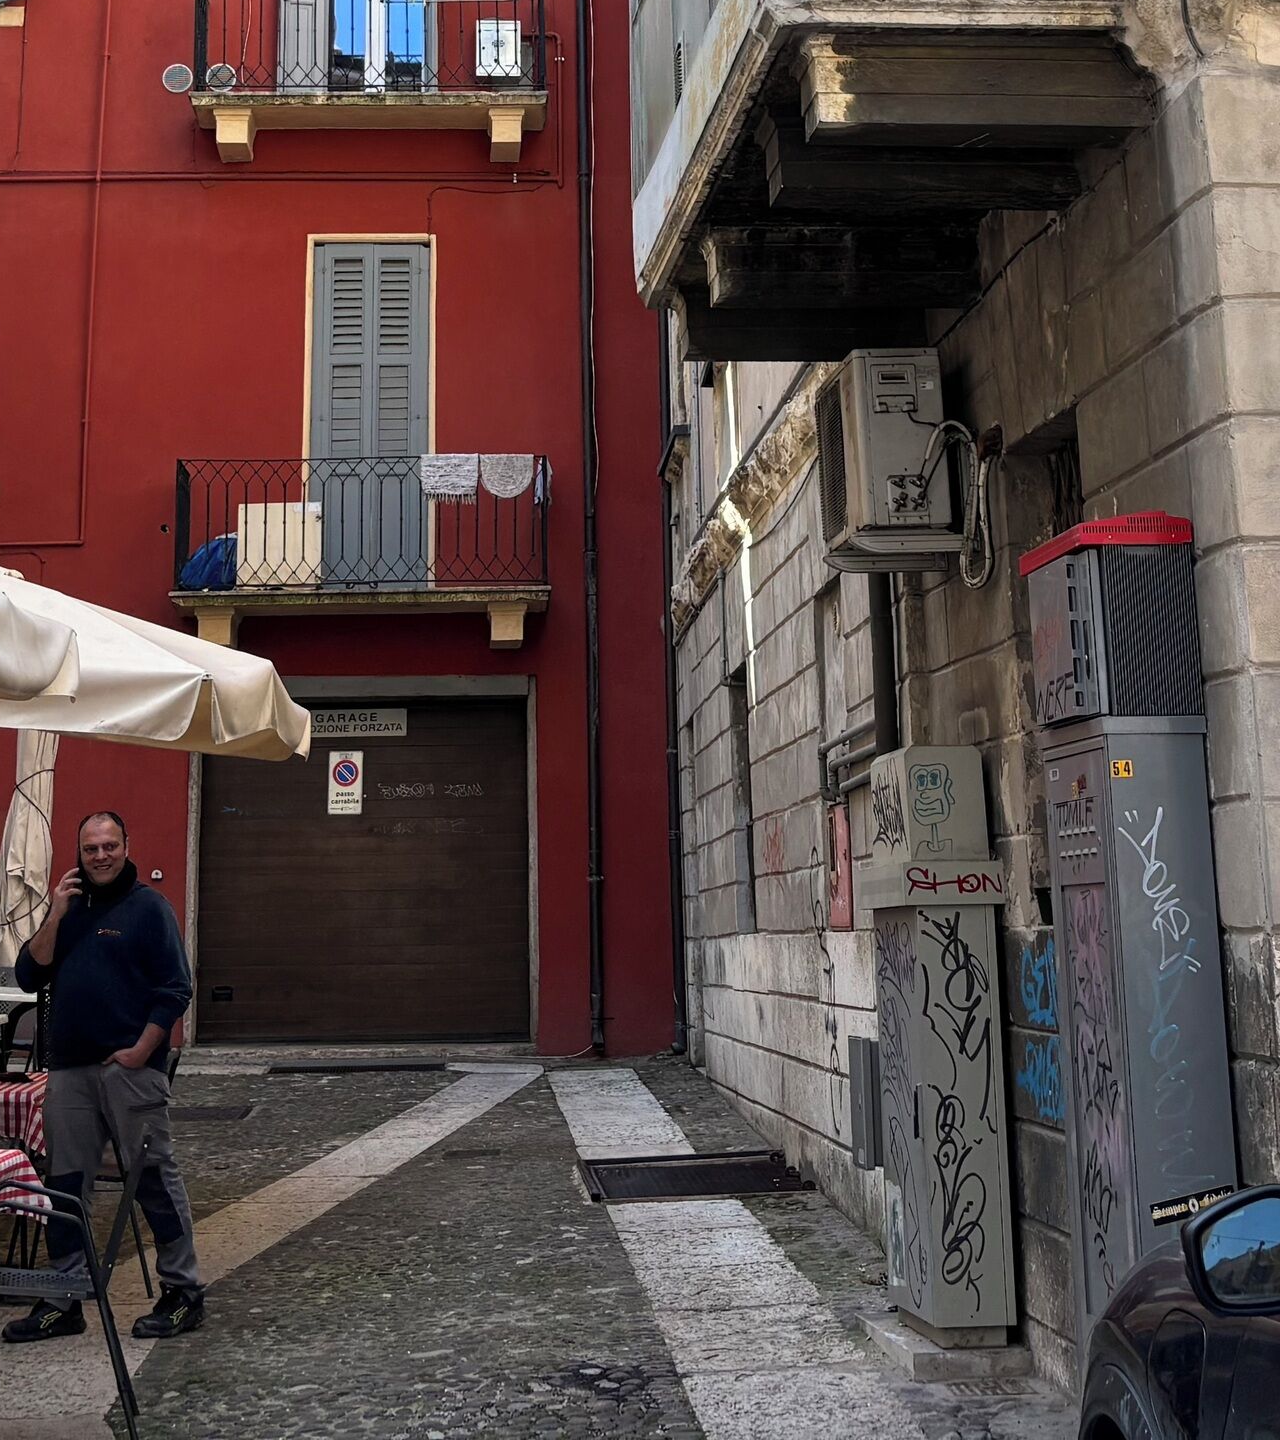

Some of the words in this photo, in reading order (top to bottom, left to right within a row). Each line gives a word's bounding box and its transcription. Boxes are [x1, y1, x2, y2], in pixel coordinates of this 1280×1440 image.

[315, 712, 378, 723] GARAGE
[311, 724, 350, 733] OZIONE
[353, 722, 403, 732] FORZATA
[330, 797, 359, 805] carrabile
